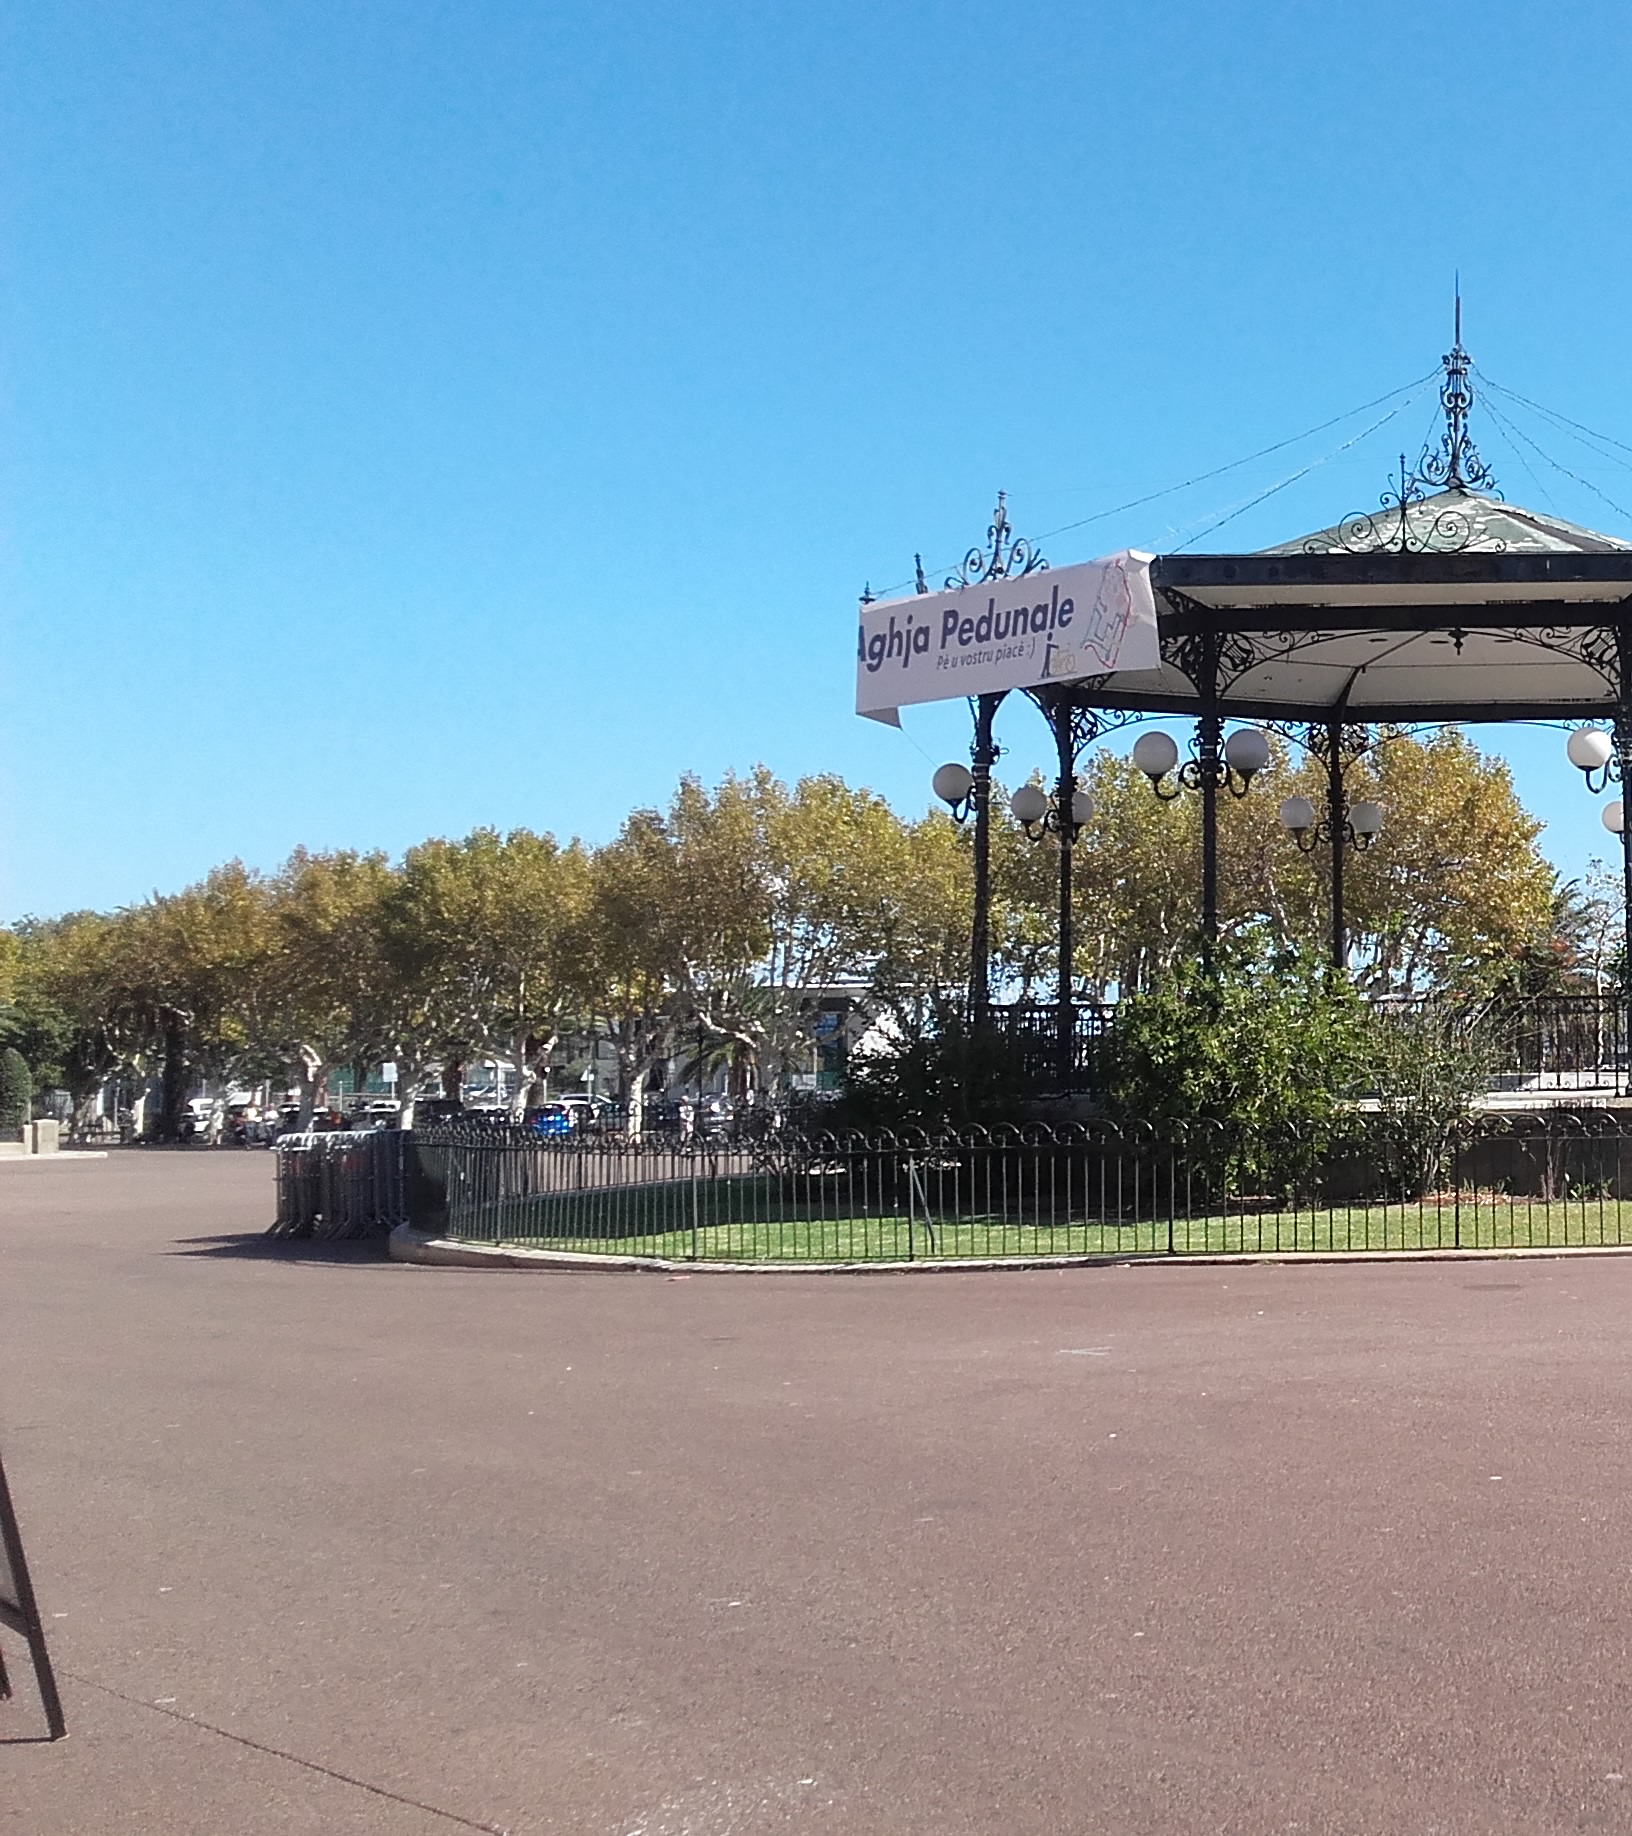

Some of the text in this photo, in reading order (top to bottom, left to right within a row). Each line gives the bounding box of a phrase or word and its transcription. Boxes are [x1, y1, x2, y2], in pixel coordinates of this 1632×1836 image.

[940, 584, 1074, 650] Pedunale
[951, 656, 958, 668] u
[960, 649, 994, 666] vostru
